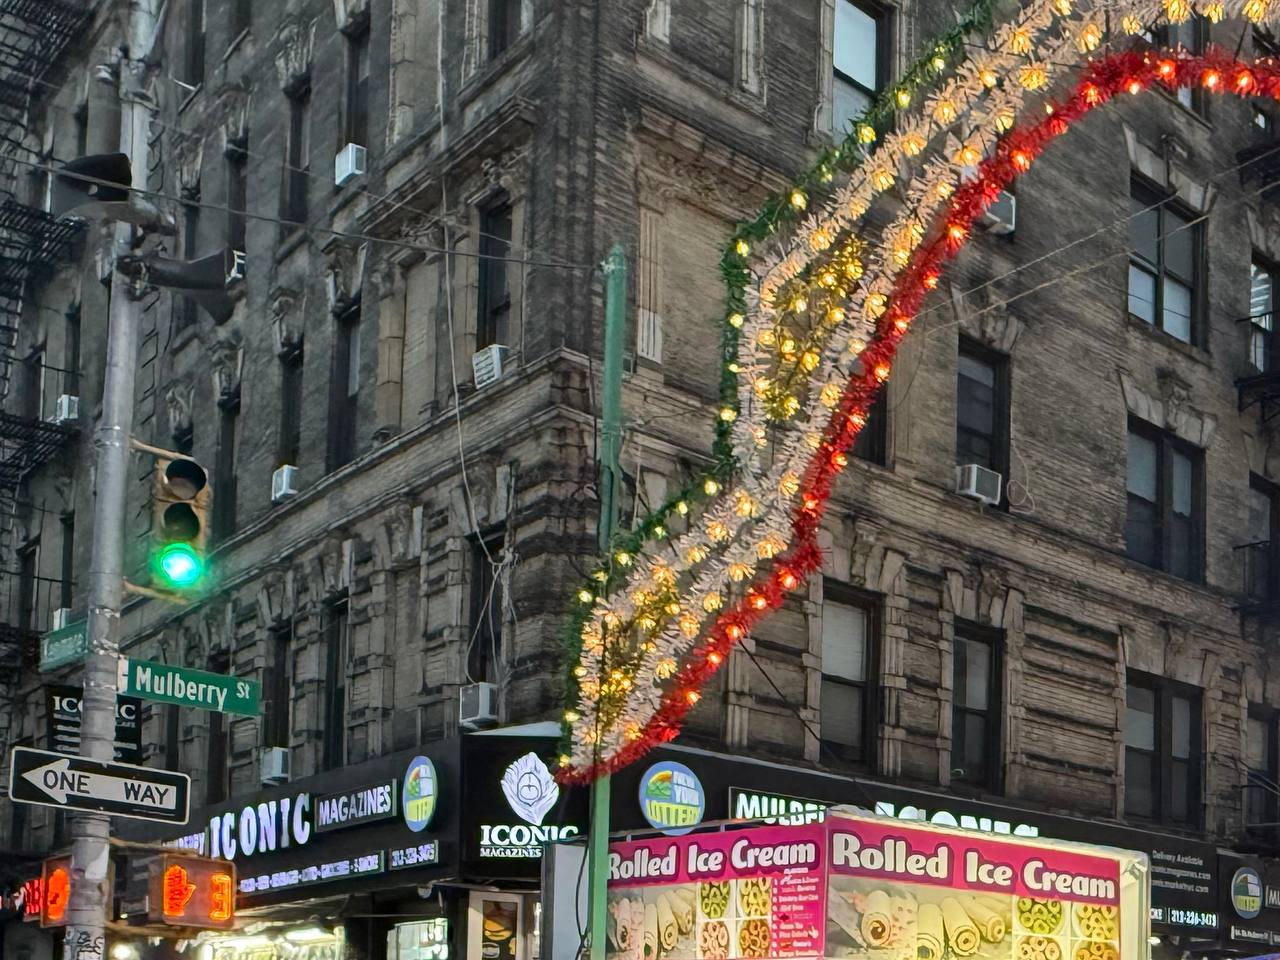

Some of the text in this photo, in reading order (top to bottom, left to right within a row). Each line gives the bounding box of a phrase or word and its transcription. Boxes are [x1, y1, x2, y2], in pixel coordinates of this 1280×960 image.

[136, 665, 250, 711] Mulberry St
[43, 769, 170, 805] ONE WAY
[210, 793, 311, 860] ICONIC
[318, 784, 392, 826] MAGAZINES
[608, 839, 816, 880] Rolled Ice Cream
[832, 832, 948, 879] Rolled
[965, 851, 1014, 886] Ice
[1023, 860, 1116, 899] Cream
